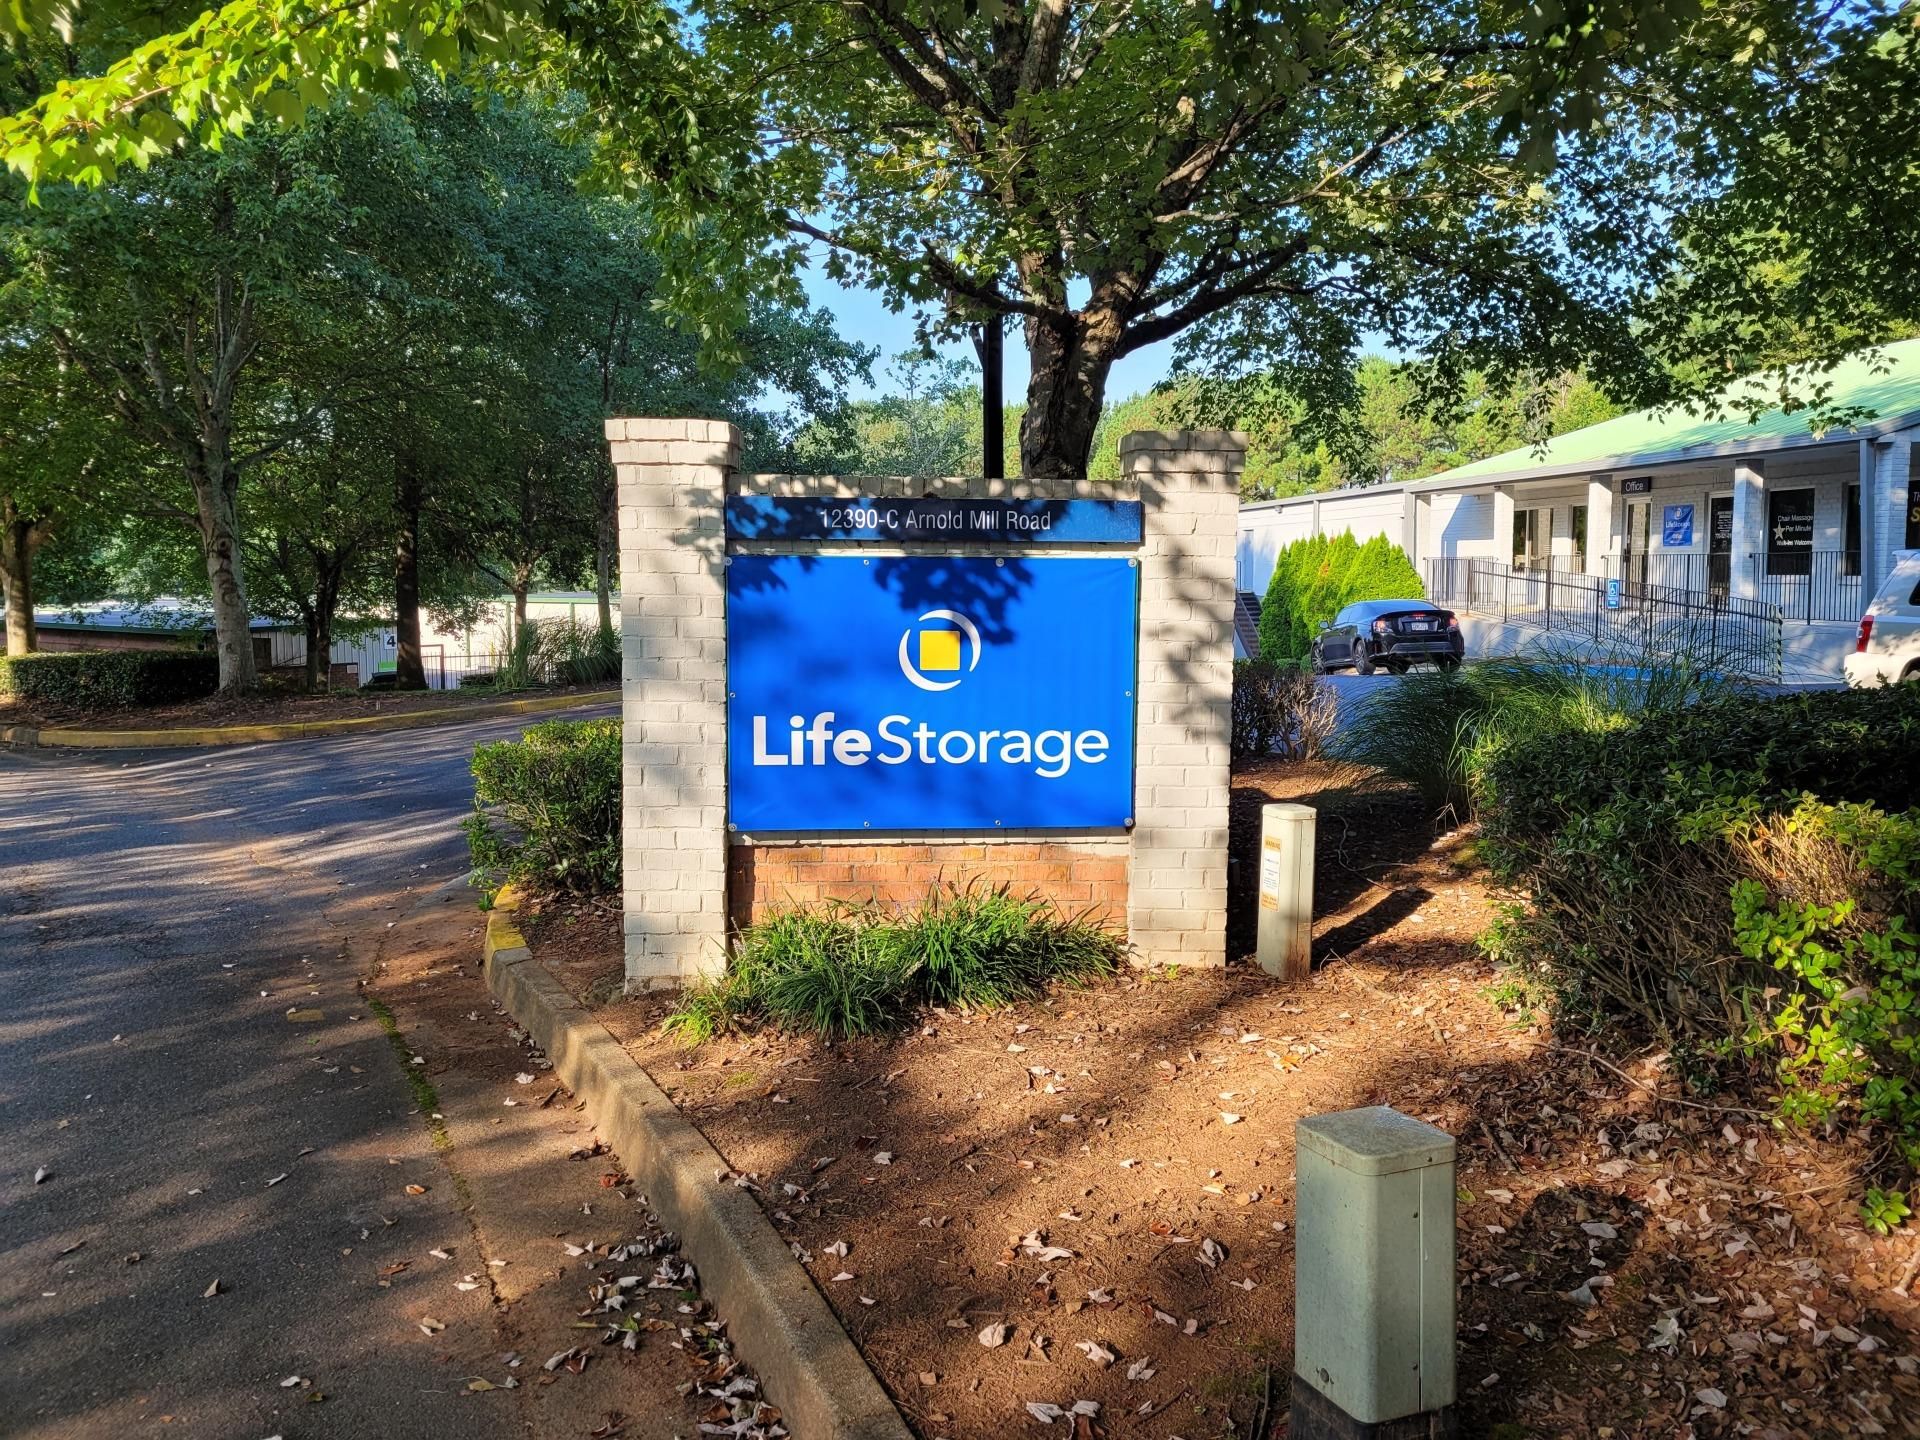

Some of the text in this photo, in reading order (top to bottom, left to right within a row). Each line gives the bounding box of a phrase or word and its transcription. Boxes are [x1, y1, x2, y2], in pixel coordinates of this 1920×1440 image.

[1625, 481, 1644, 492] Office
[819, 509, 1051, 530] 12390-C Arnold Mill Road
[753, 711, 1110, 778] Life Storage
